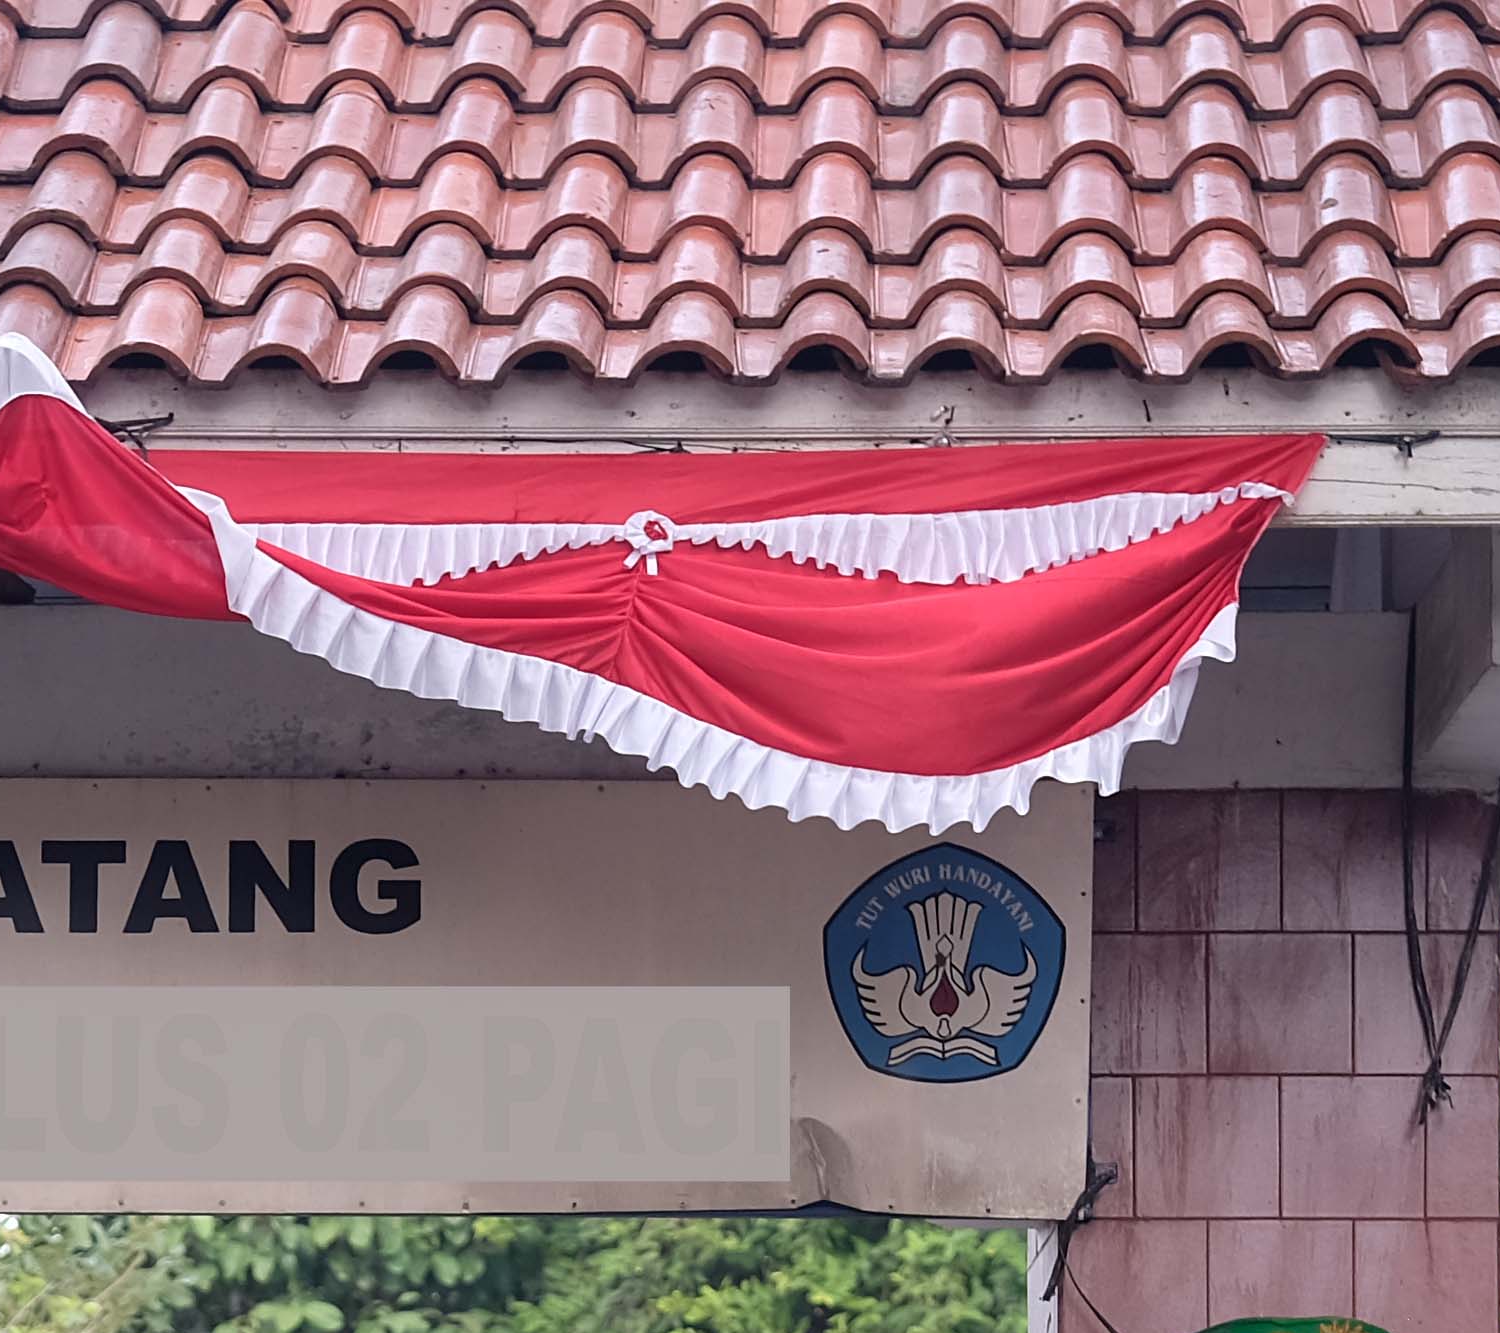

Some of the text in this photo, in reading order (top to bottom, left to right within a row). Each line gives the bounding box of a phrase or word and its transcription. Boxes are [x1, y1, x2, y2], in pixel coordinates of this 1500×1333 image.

[855, 863, 1034, 933] TUT WURI HANDAYANI
